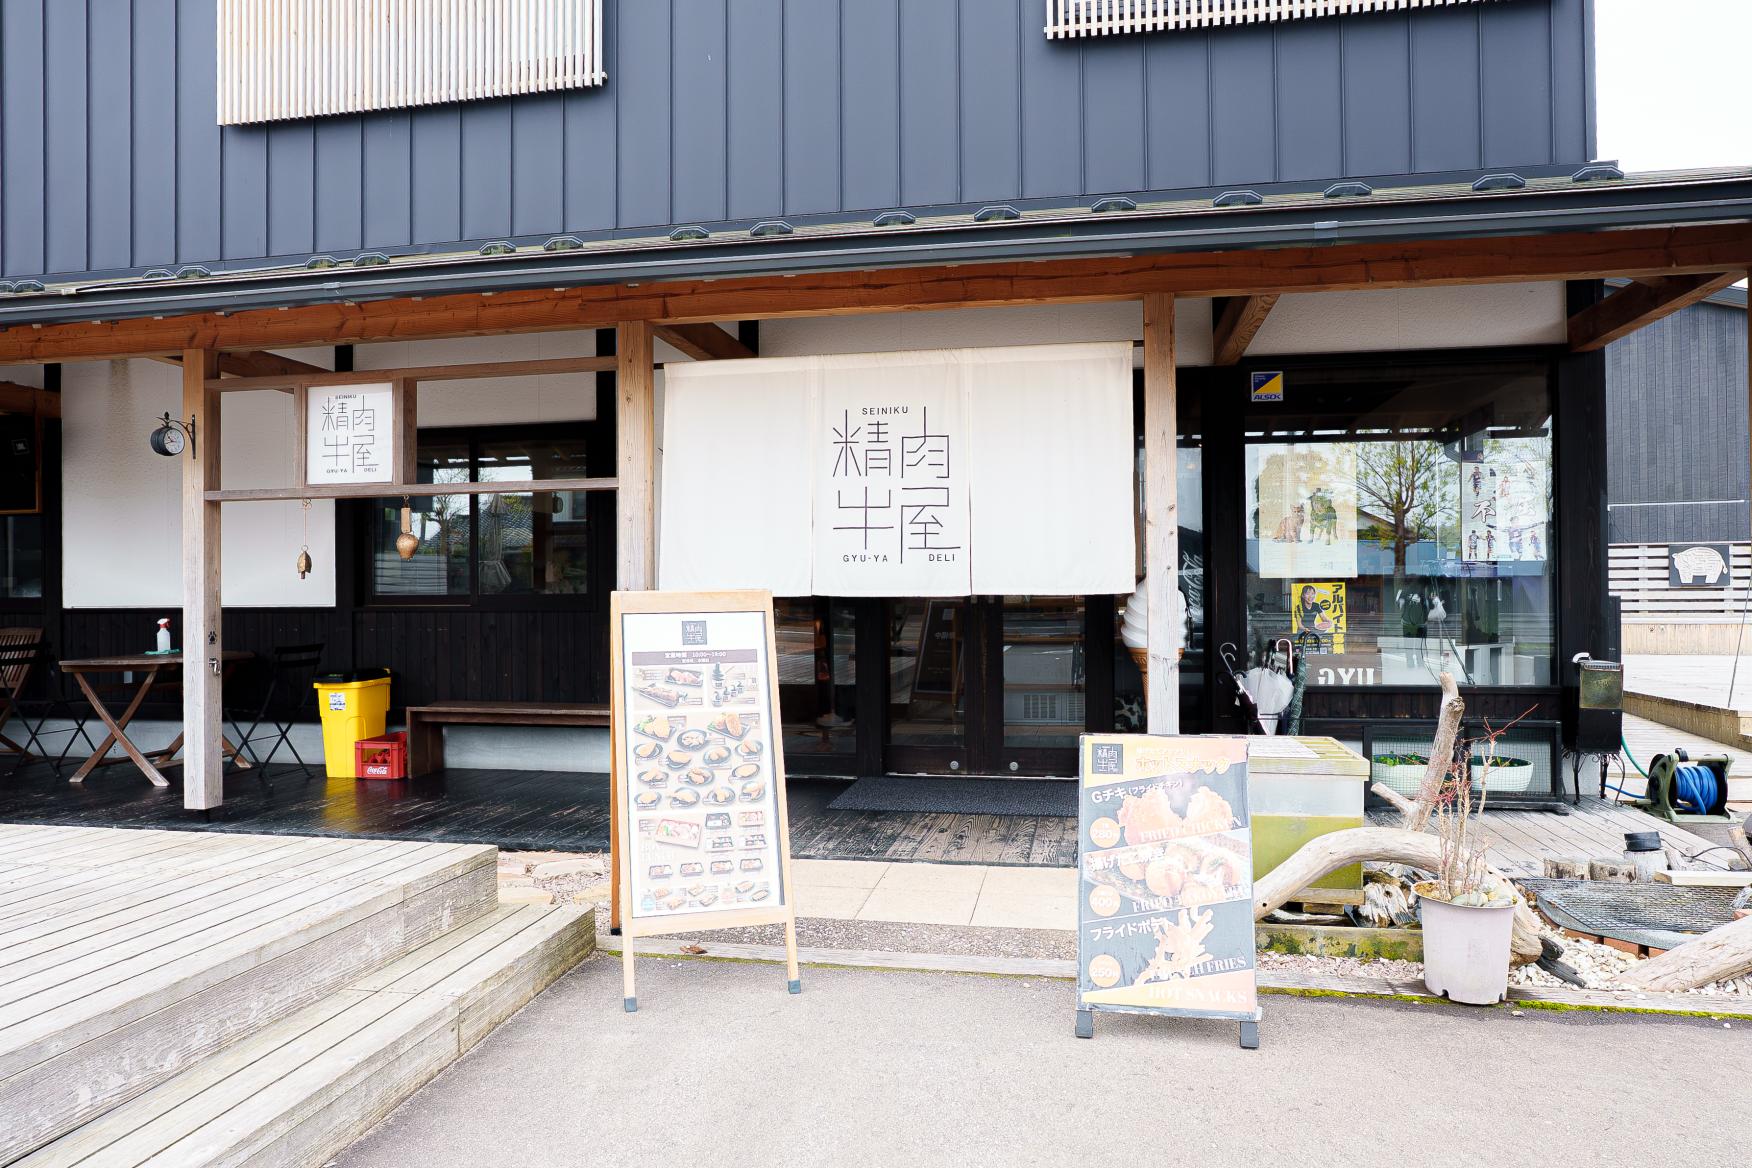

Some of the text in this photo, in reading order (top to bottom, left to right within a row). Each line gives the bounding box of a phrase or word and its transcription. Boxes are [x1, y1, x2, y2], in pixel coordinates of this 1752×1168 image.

[861, 406, 909, 415] SEINIKU
[833, 406, 949, 479] 精肉
[843, 553, 955, 563] GYU-YA DELI
[1331, 584, 1344, 631] アルバイト
[1091, 786, 1127, 804] Gチキ
[1139, 826, 1182, 842] FRIED
[1206, 956, 1247, 972] FRIES
[1148, 987, 1247, 1004] HOT SNACKS
